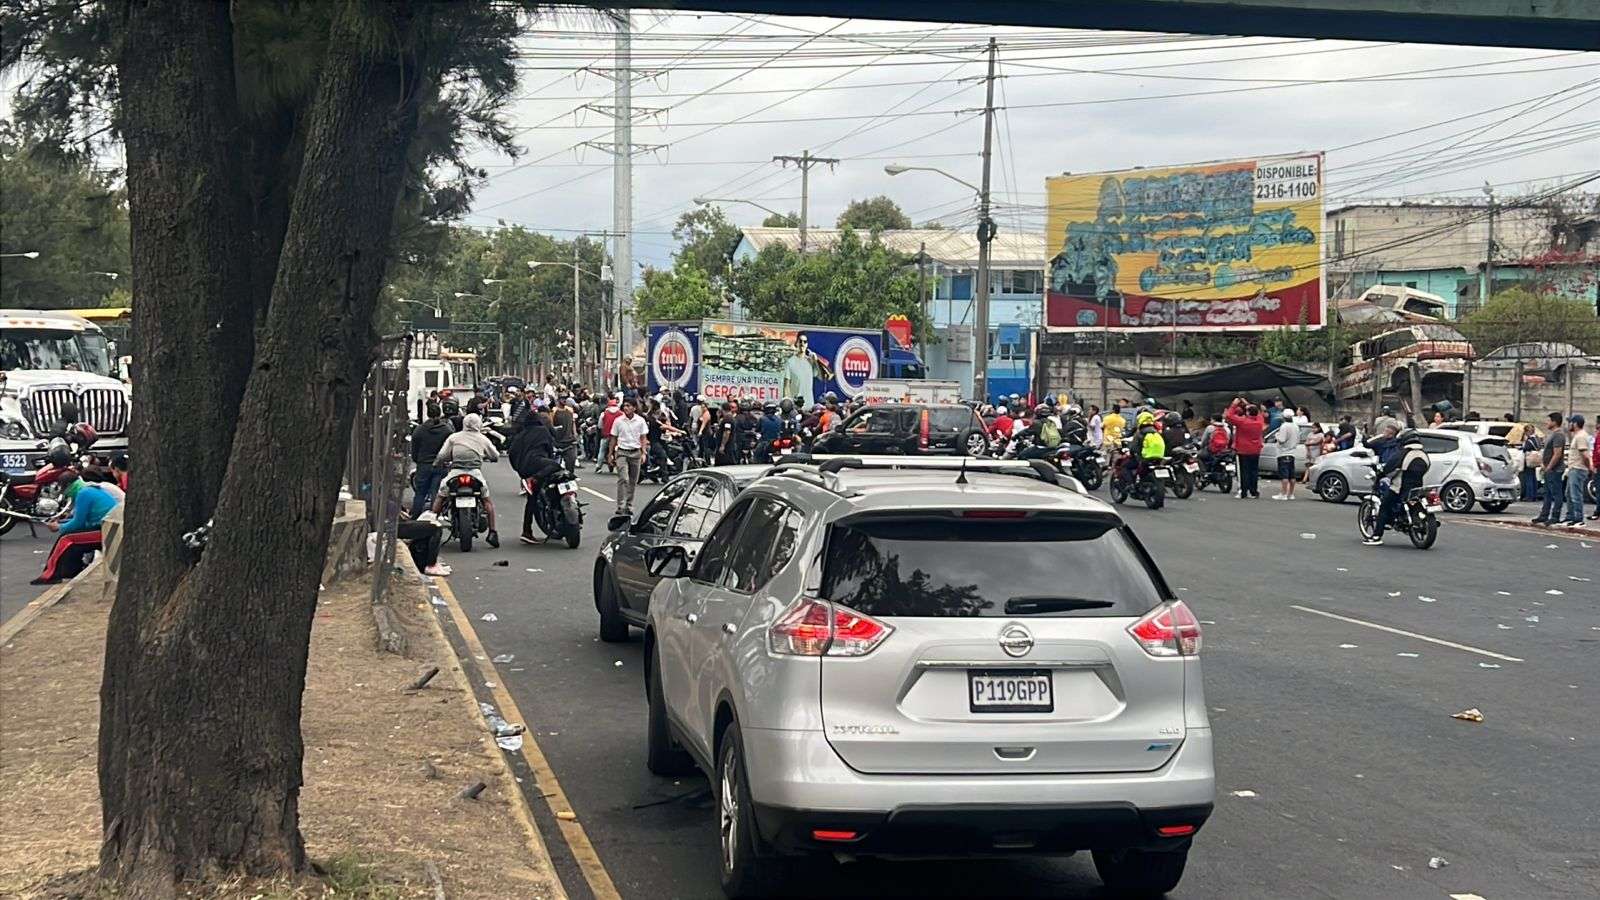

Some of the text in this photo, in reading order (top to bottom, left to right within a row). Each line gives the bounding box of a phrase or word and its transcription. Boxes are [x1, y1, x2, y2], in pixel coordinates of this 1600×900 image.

[1256, 165, 1317, 179] DISPONIBLE:
[1256, 182, 1316, 199] 2316-1100
[661, 351, 685, 364] tmu
[845, 357, 869, 371] tmu
[704, 374, 779, 385] SIEMPRE UNA TIENDA
[704, 384, 779, 400] CERCA DE TI
[2, 454, 27, 468] 3523
[975, 680, 1048, 701] P119GPP
